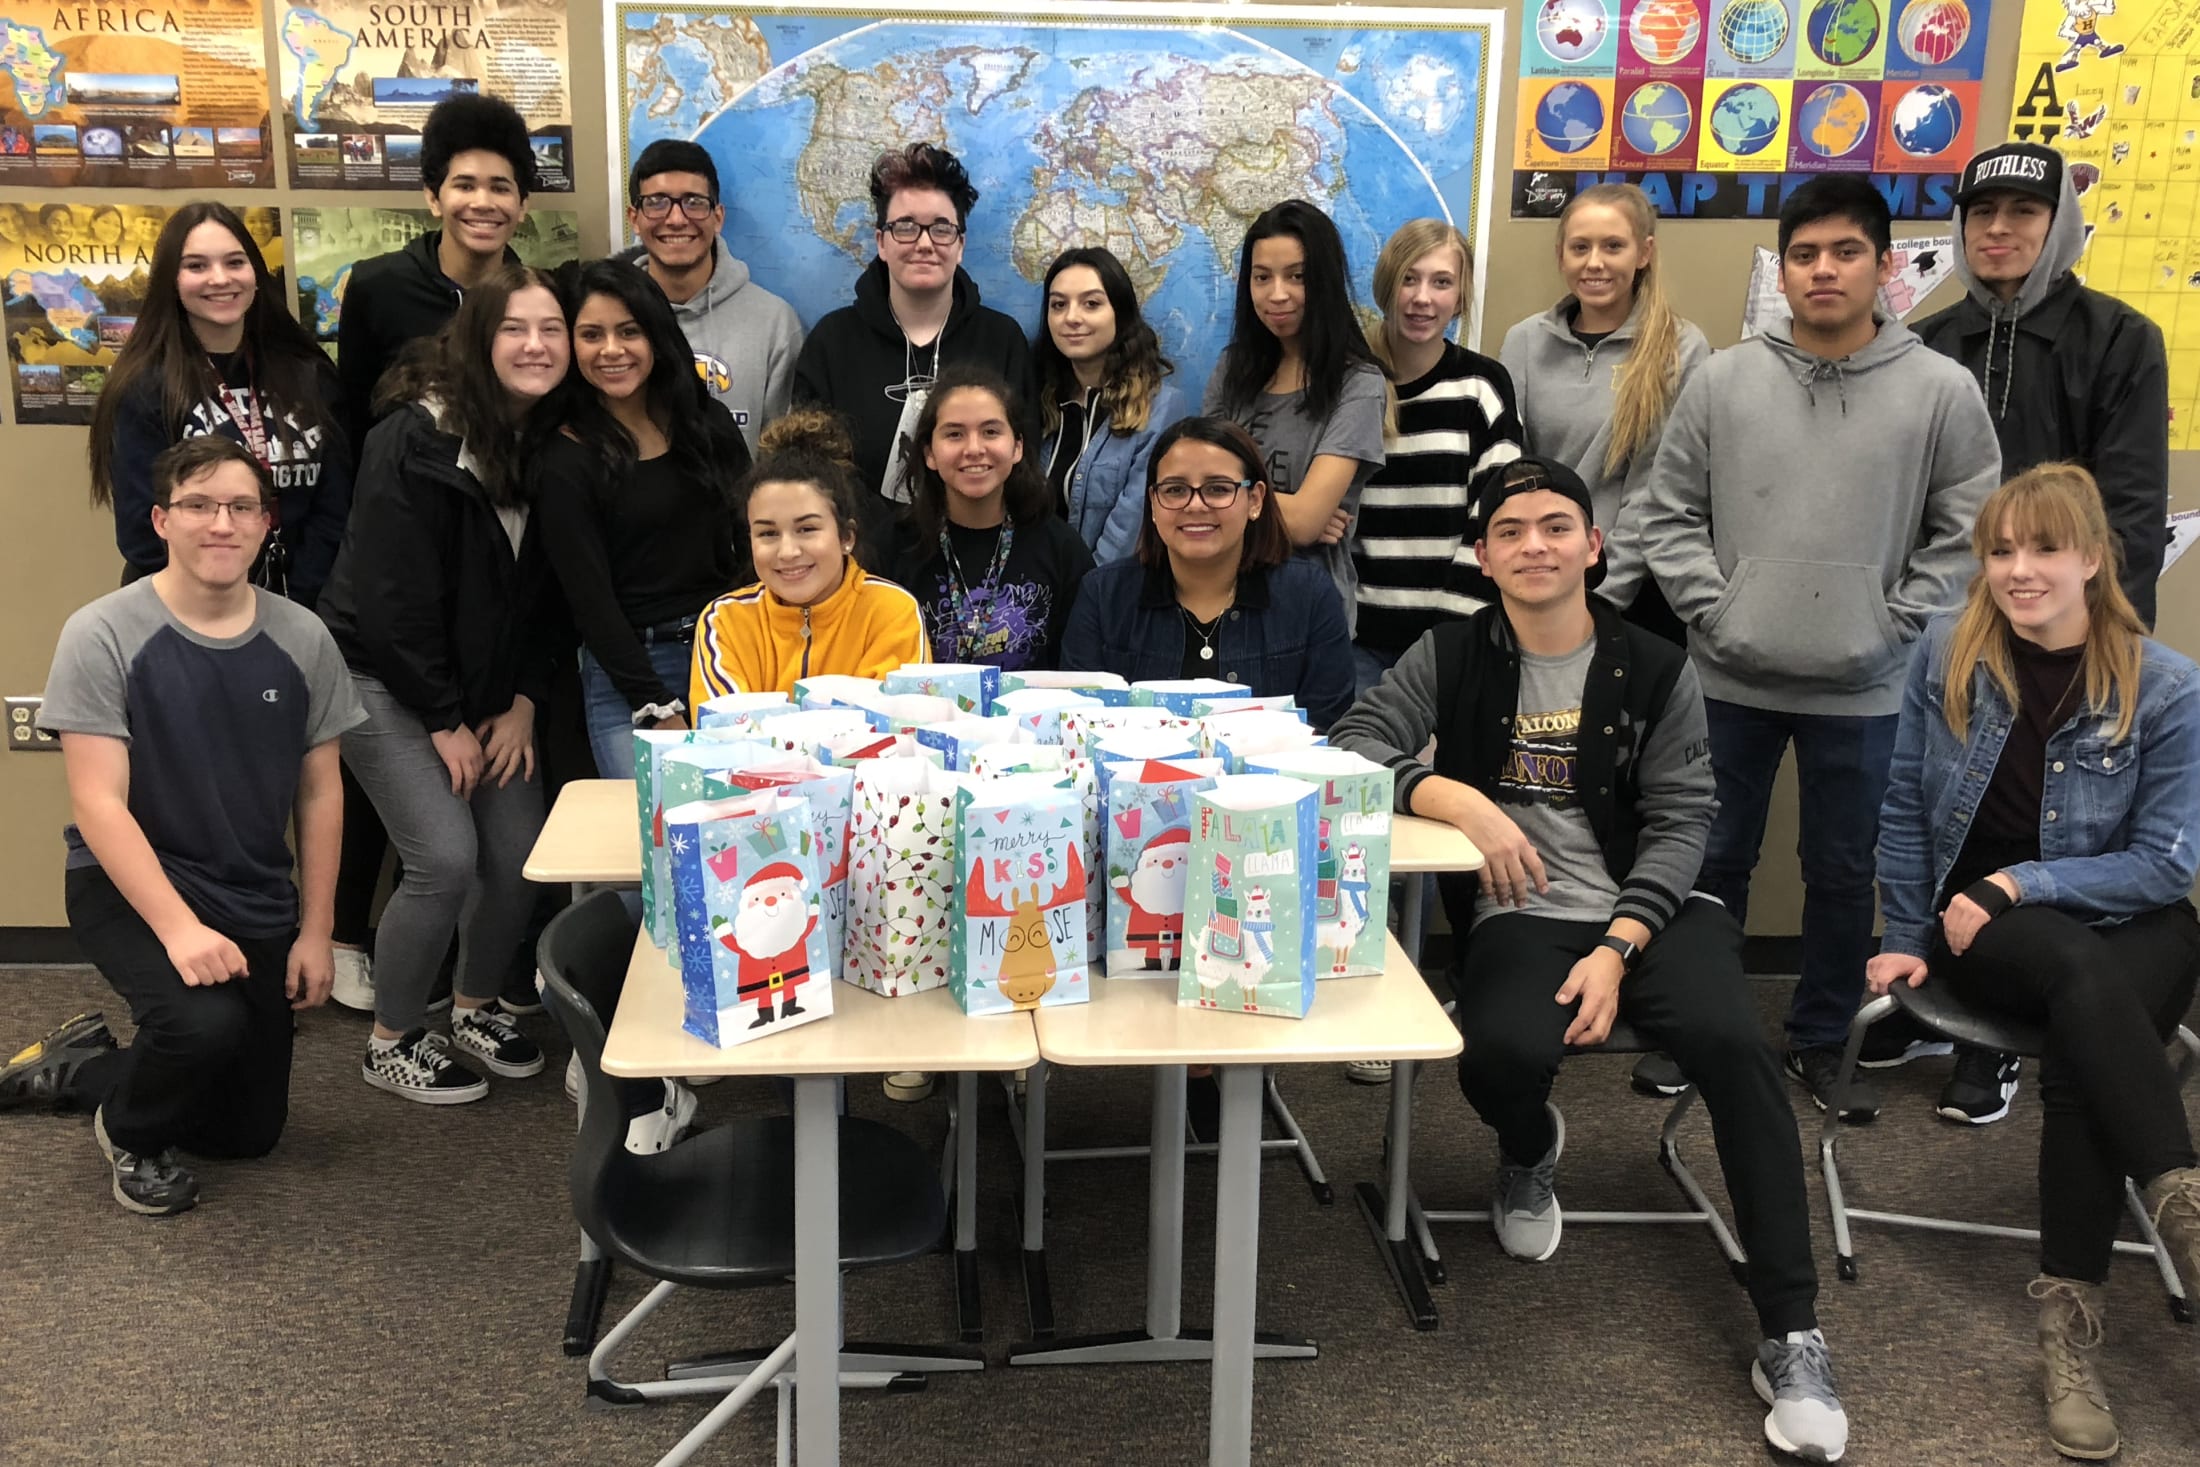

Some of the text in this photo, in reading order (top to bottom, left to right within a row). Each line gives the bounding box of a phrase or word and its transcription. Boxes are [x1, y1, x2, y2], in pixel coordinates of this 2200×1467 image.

[53, 7, 181, 33] AFRICA
[370, 4, 472, 27] SOUTH
[355, 28, 492, 50] AMERICA
[1700, 159, 1730, 169] Equator
[1973, 154, 2047, 186] RUTHLESS
[24, 242, 120, 265] NORTH
[1896, 240, 1931, 250] college
[989, 830, 1066, 852] merry
[993, 847, 1059, 883] KISS
